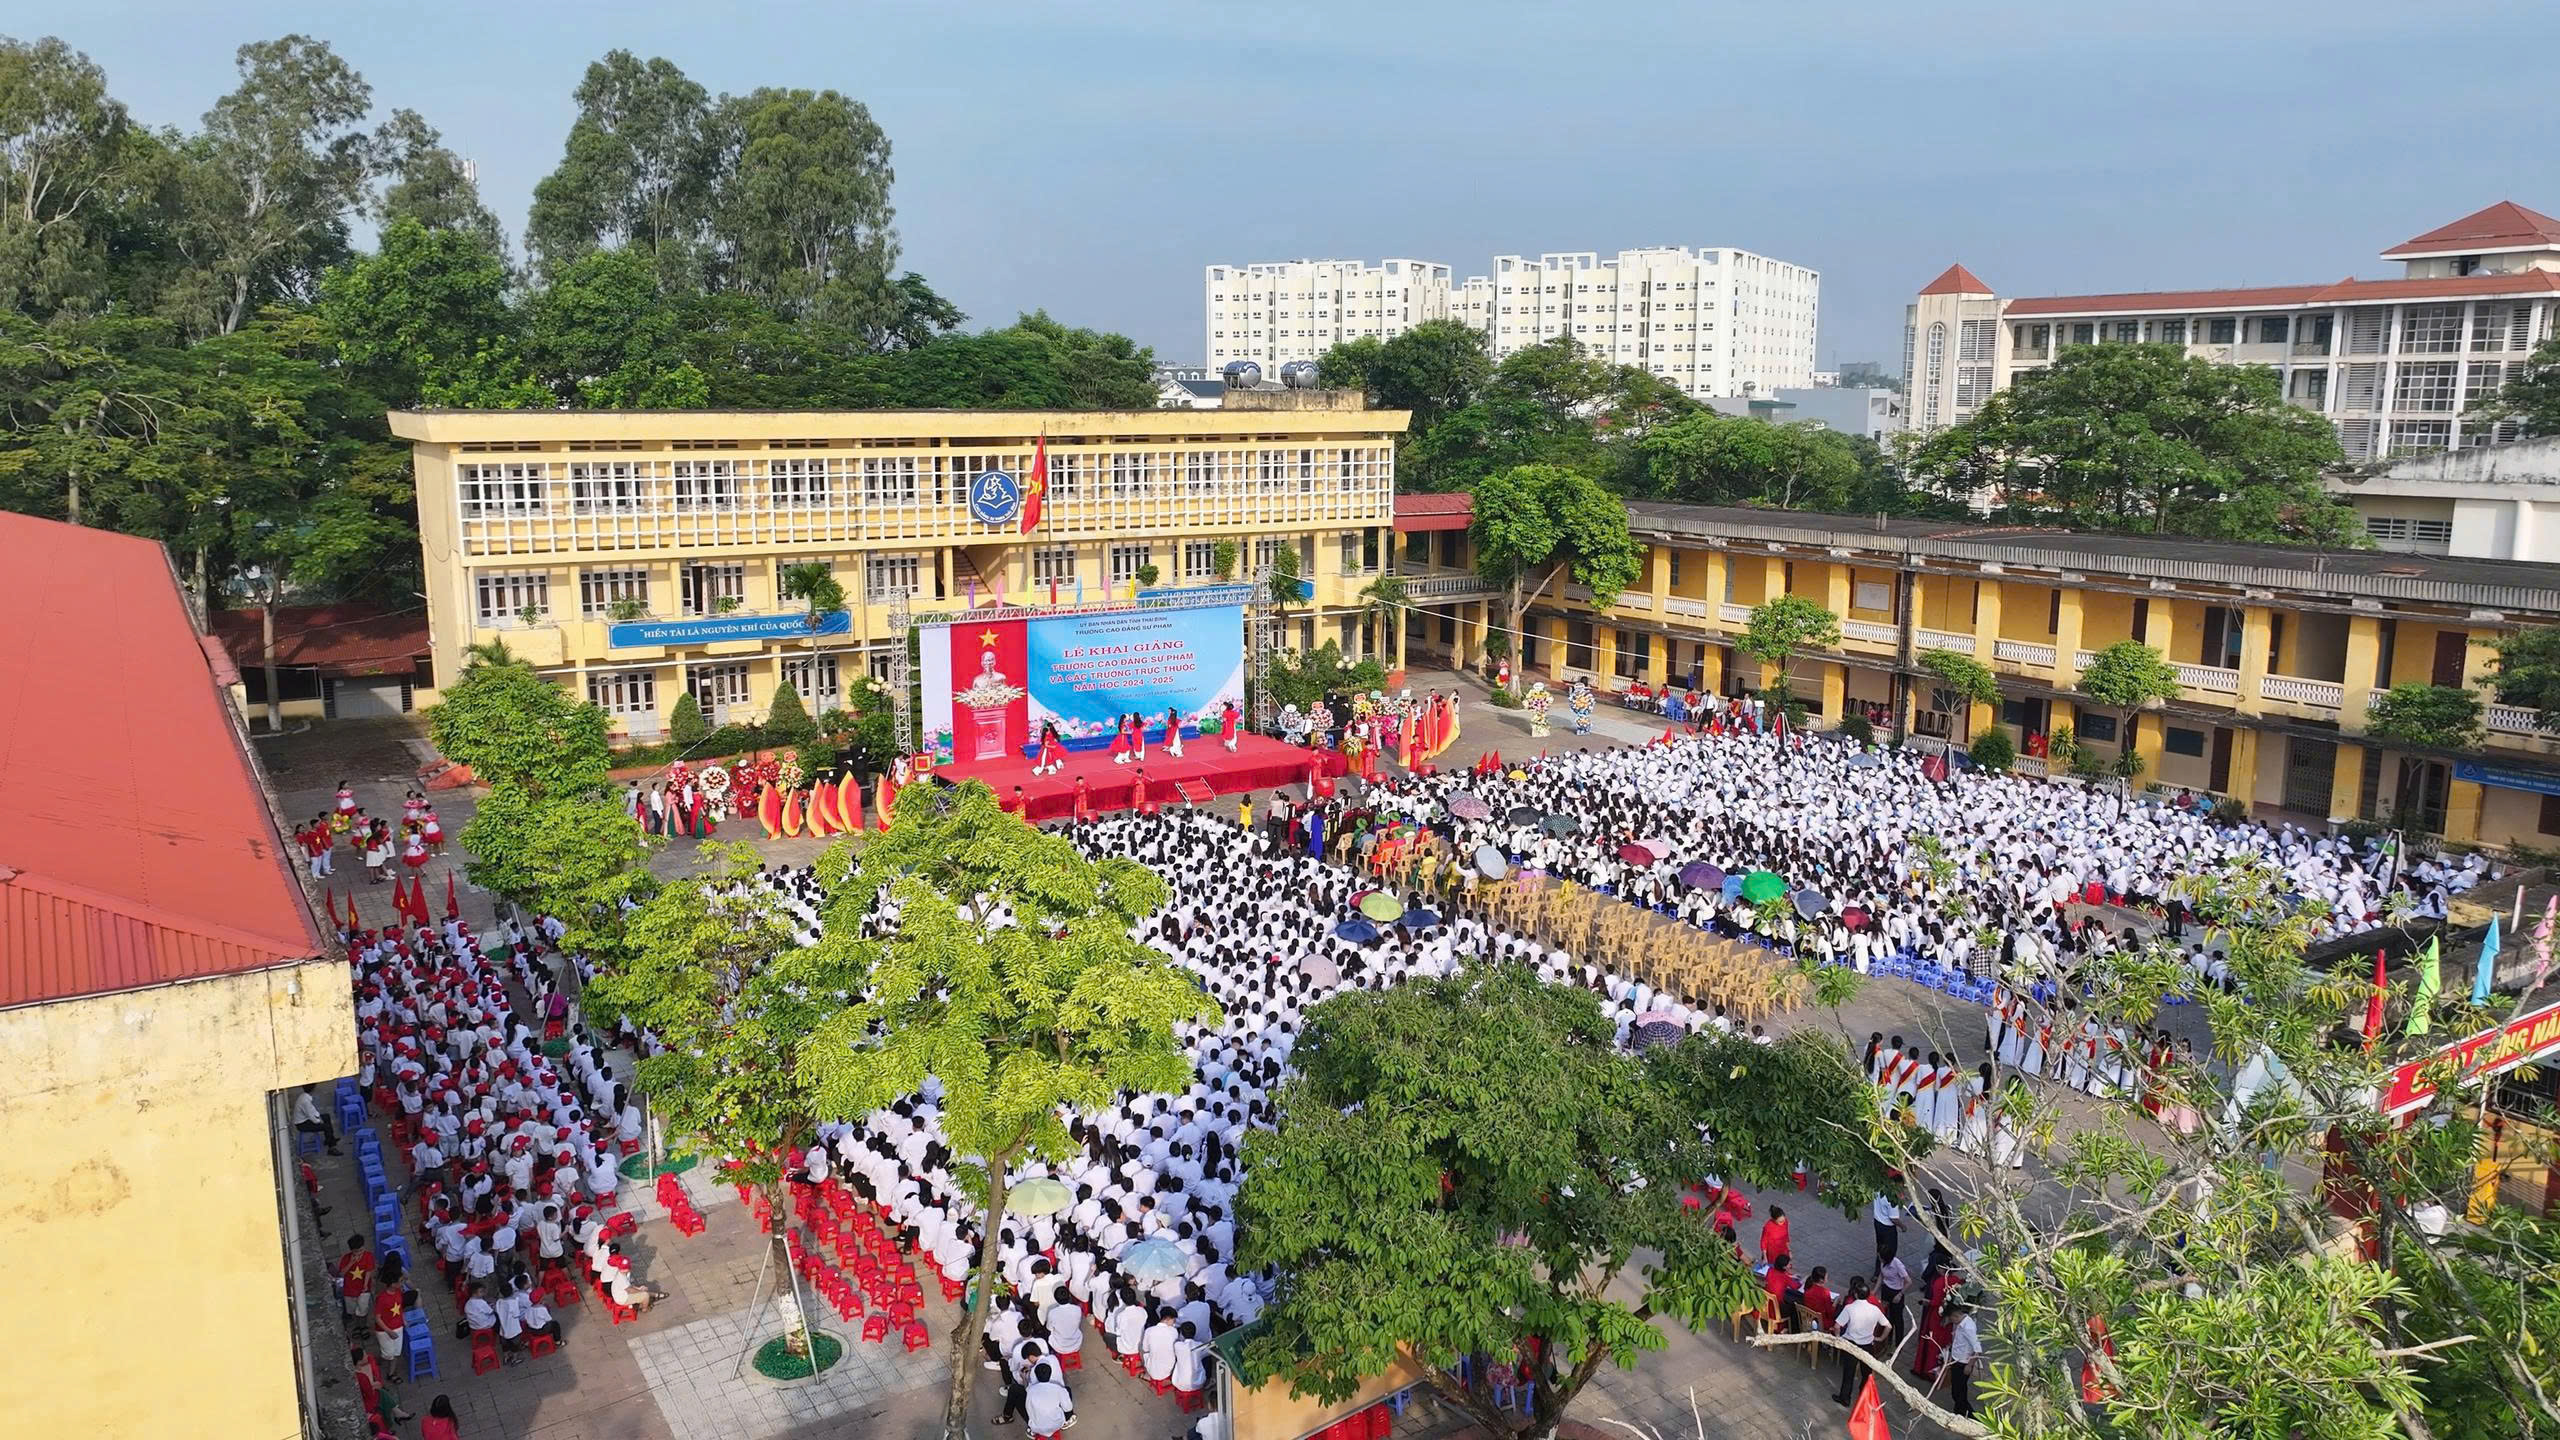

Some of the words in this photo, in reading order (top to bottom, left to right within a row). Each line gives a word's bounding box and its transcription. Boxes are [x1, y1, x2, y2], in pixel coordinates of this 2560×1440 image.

[701, 624, 739, 635] NGUYÊN
[740, 622, 758, 632] KHÍ
[759, 621, 777, 631] CỦA
[778, 618, 805, 630] QUỐC
[1105, 626, 1121, 634] CAO
[1088, 645, 1129, 657] KHAI
[1133, 639, 1184, 652] GIẢNG
[1097, 659, 1118, 669] CAO
[1120, 655, 1148, 666] ĐẲNG
[1150, 654, 1165, 664] SƯ
[1166, 652, 1194, 663] PHẠM
[1122, 677, 1144, 687] 2024
[1152, 675, 1174, 685] 2025
